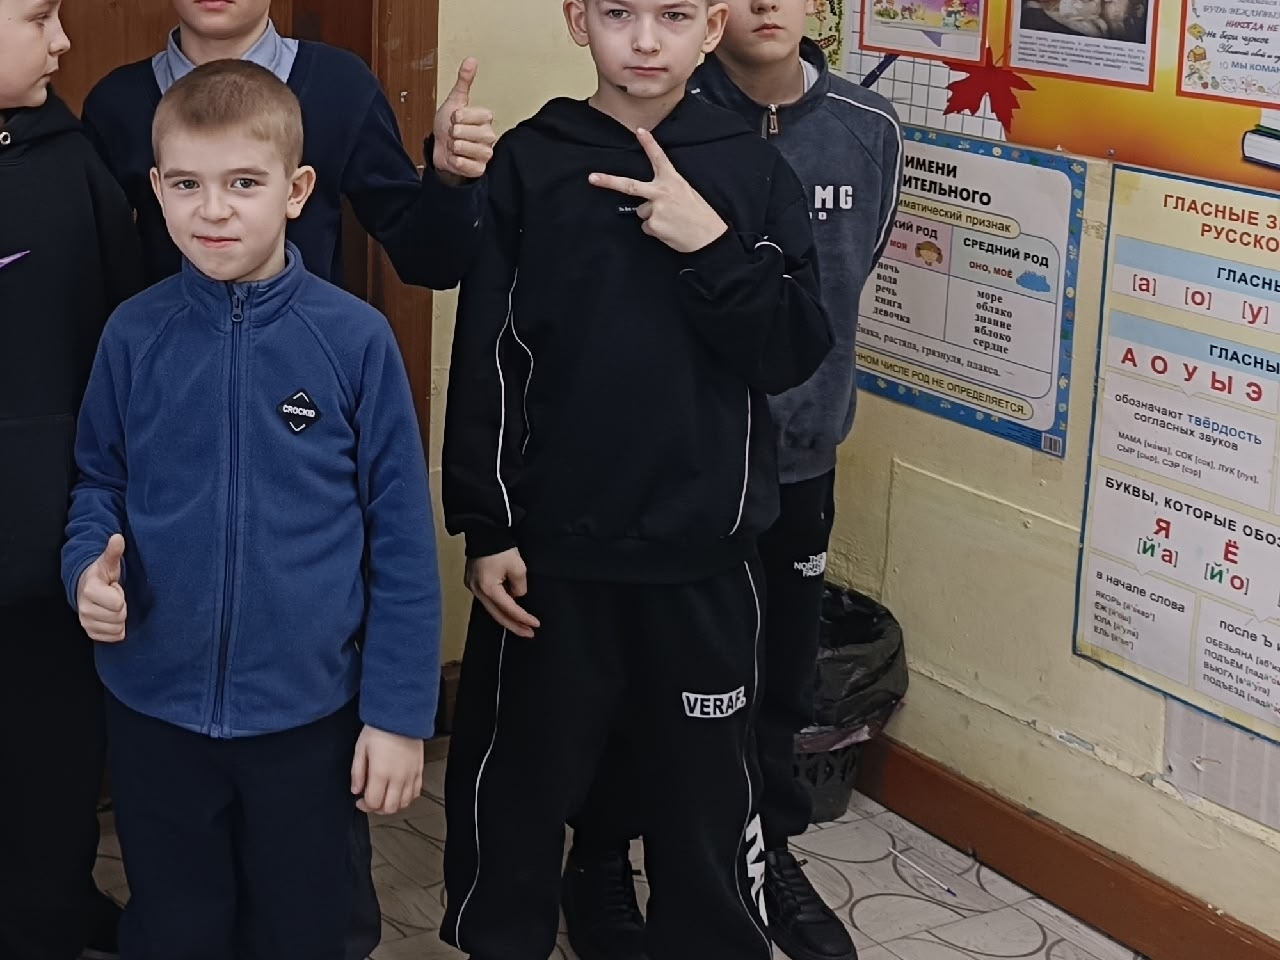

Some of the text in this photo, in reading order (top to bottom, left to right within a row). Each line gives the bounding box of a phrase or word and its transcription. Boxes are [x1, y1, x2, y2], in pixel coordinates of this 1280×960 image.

[905, 155, 957, 179] ИМЕНИ
[903, 174, 992, 206] ИТЕЛЬНОГО
[965, 215, 1012, 234] признак
[1163, 194, 1280, 230] ГЛАСНЫЕ З
[915, 225, 938, 240] РОД
[1201, 223, 1280, 253] РУССКО
[963, 237, 1049, 269] СРЕДНИЙ РОД
[874, 295, 902, 310] книга
[875, 284, 897, 297] речь
[976, 291, 1003, 304] море
[872, 306, 911, 324] девочка
[974, 314, 1012, 331] знание
[976, 302, 1013, 319] облако
[973, 337, 1009, 355] сердце
[974, 325, 1012, 343] яблоко
[966, 360, 1001, 377] плакса.
[1209, 344, 1280, 375] ГЛАСНЫ
[1121, 347, 1263, 402] А О У Ы Э
[881, 360, 1027, 416] ЧИСЛЕ РОД НЕ ОПРЕДЕЛЯЕТСЯ.
[1115, 393, 1263, 446] обозначают твёрдость
[1134, 412, 1239, 452] согласных звуков
[1116, 444, 1135, 455] СЫР
[1162, 458, 1181, 469] СЭР
[1118, 431, 1236, 475] МАМА СОК ЛУК
[1105, 476, 1158, 506] БУКВЫ,
[1164, 497, 1237, 532] КОТОРЫЕ
[1153, 517, 1240, 565] Я Ё
[1095, 590, 1122, 607] ЯКОРЬ
[1096, 571, 1185, 613] в начале слова
[1219, 620, 1273, 648] после Ъ
[1205, 636, 1253, 661] ОБЕЗЬЯНА
[1203, 661, 1234, 681] ВЬЮГА
[1203, 673, 1246, 699] ПОДЪЕЗД
